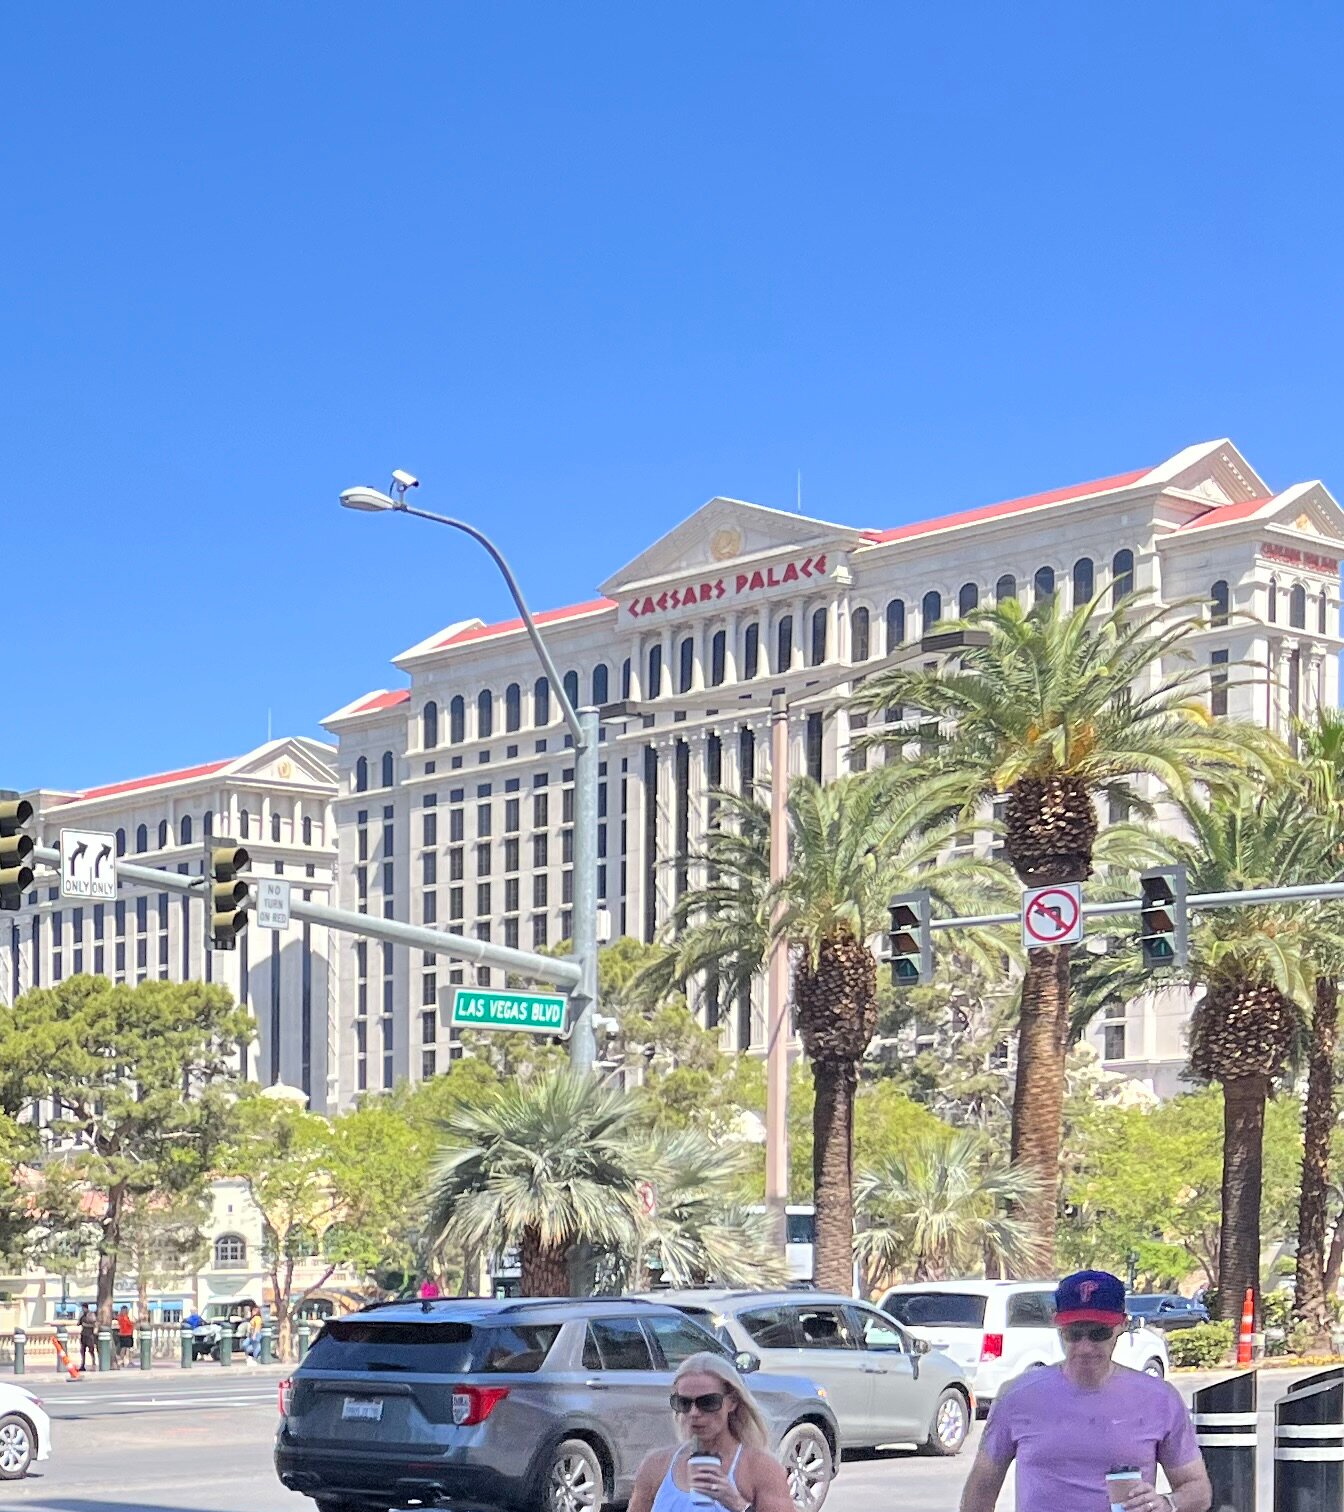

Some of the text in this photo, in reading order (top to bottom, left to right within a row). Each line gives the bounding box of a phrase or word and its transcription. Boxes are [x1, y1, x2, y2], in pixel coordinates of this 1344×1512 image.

[628, 553, 827, 618] CAESARS PALACE
[65, 880, 113, 895] ONLY ONLY
[267, 885, 280, 895] NO
[264, 898, 283, 909] TURN
[260, 912, 286, 923] ON RED
[458, 998, 561, 1022] LAS VEGAS BLVD
